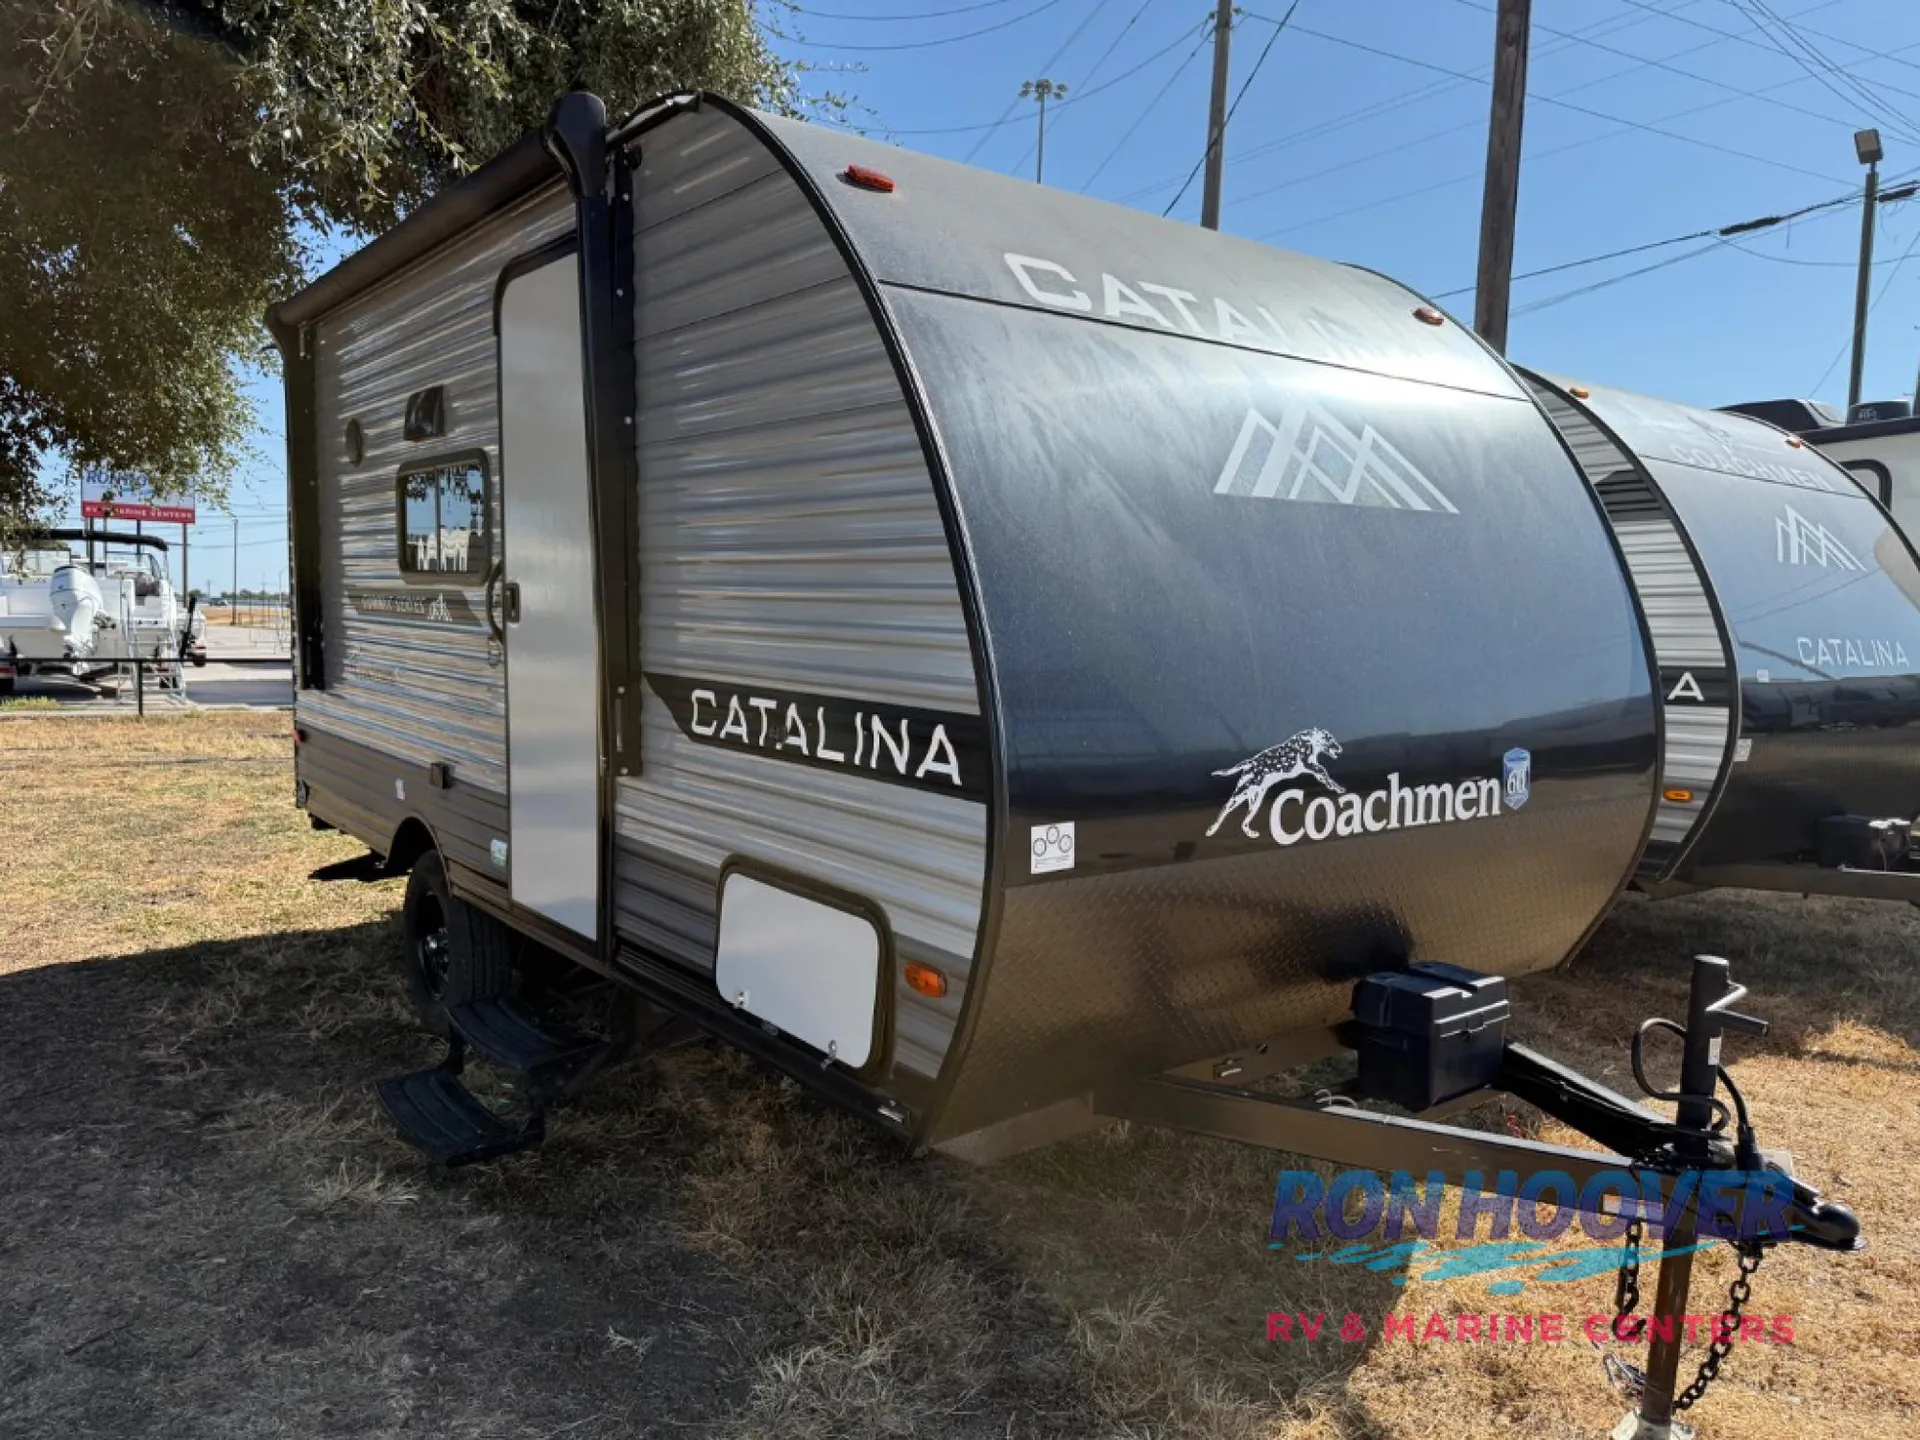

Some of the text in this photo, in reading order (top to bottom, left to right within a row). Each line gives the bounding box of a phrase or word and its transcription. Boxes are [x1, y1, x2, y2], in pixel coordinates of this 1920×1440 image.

[1797, 636, 1910, 667] CATALINA
[691, 689, 962, 786] CATALINA
[1269, 772, 1500, 845] Coachmen
